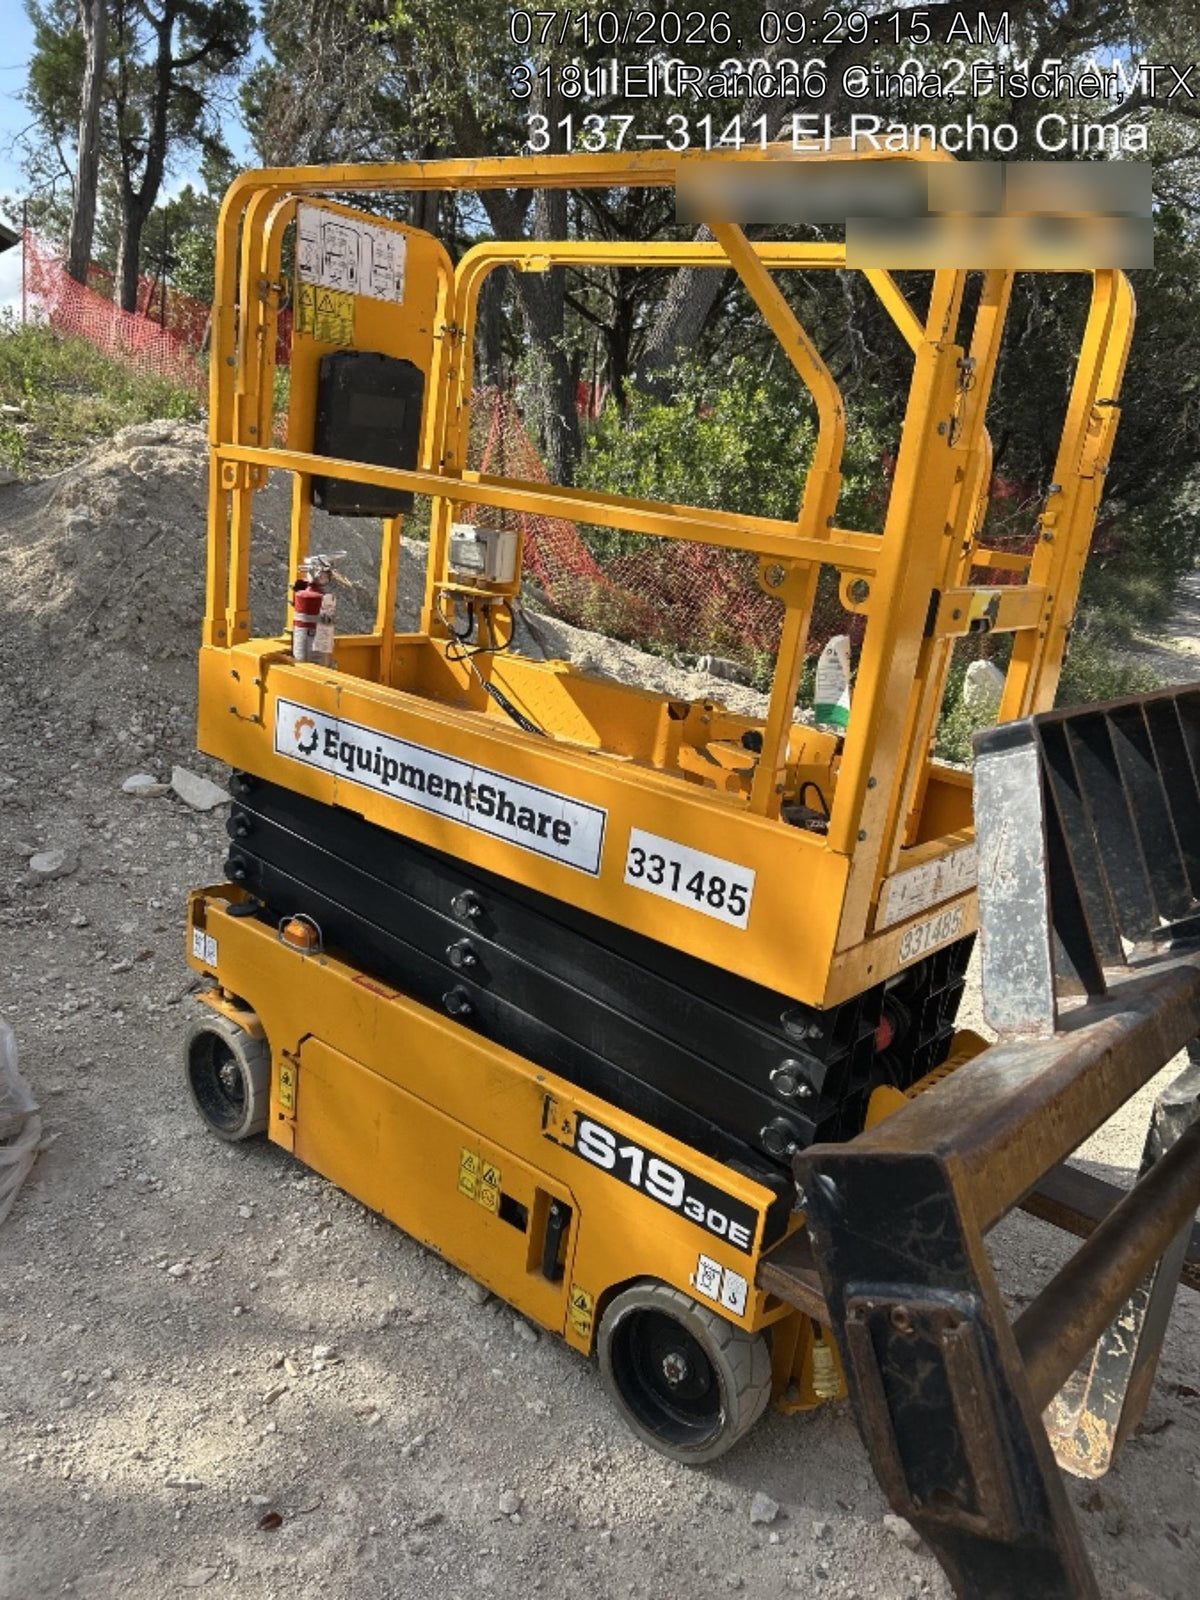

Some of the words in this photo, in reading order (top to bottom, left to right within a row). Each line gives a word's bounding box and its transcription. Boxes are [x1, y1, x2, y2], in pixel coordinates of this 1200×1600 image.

[323, 728, 572, 847] EquipmentShare
[628, 847, 748, 917] 331485
[901, 904, 964, 960] 331485
